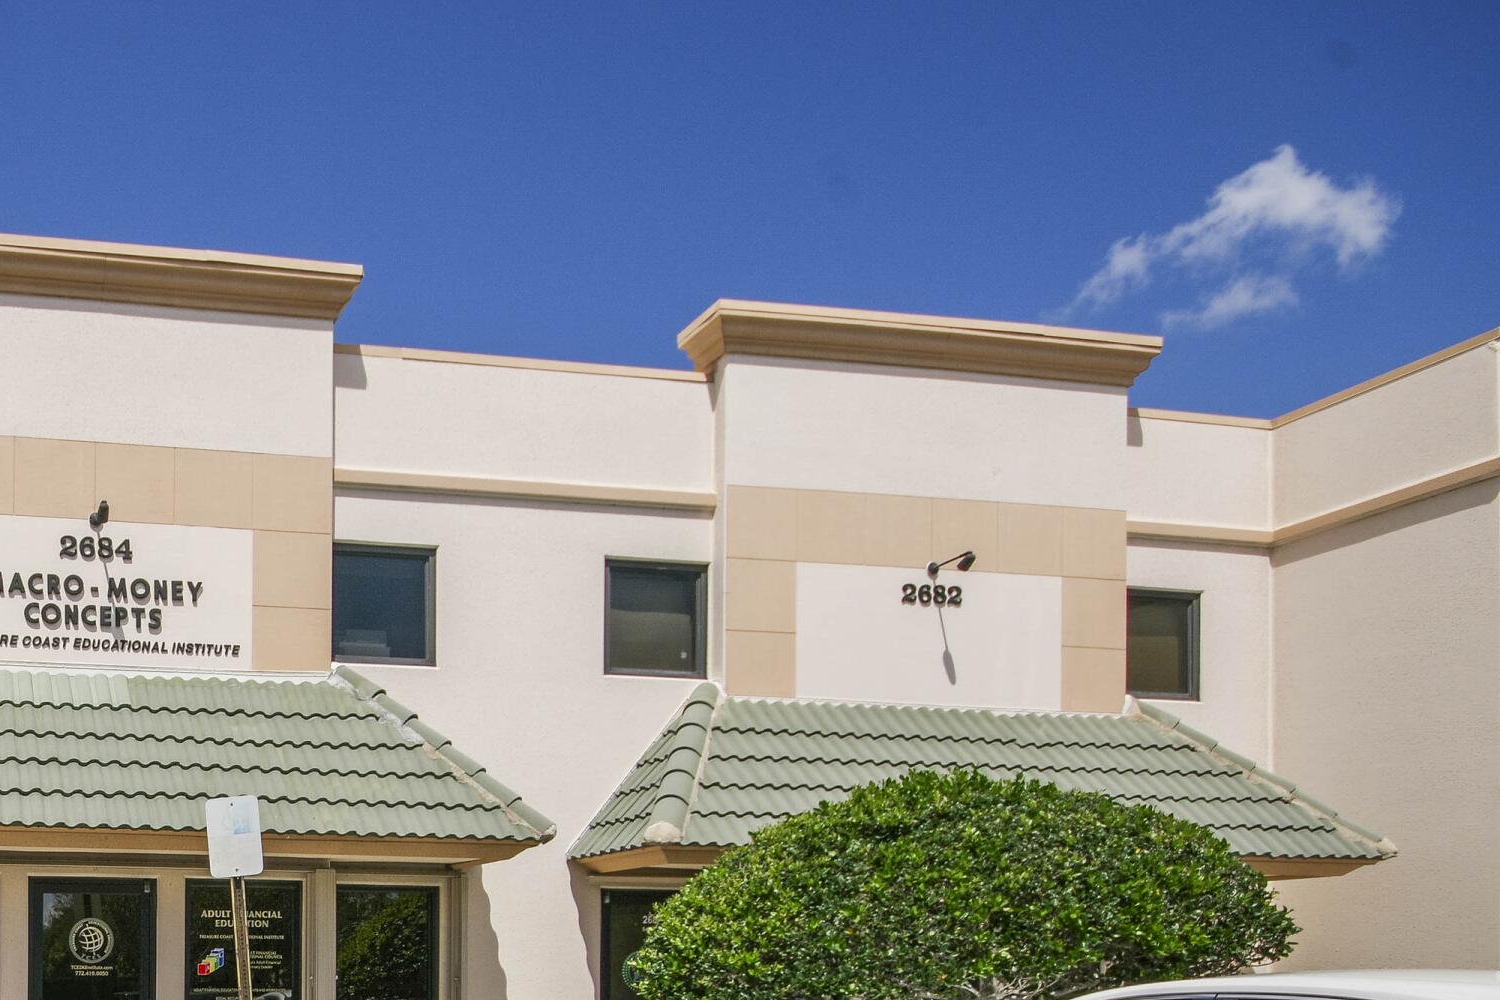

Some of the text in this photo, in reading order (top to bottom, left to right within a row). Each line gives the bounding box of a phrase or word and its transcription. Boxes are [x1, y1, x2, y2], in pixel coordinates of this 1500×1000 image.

[60, 535, 133, 560] 2684
[901, 583, 963, 606] 2682
[24, 602, 163, 631] CONCEPTS
[22, 636, 70, 650] COAST
[73, 638, 169, 655] EDUCATIONAL
[171, 642, 241, 657] INSTITUTE
[201, 910, 232, 918] ADULT
[215, 920, 269, 928] EDUTION
